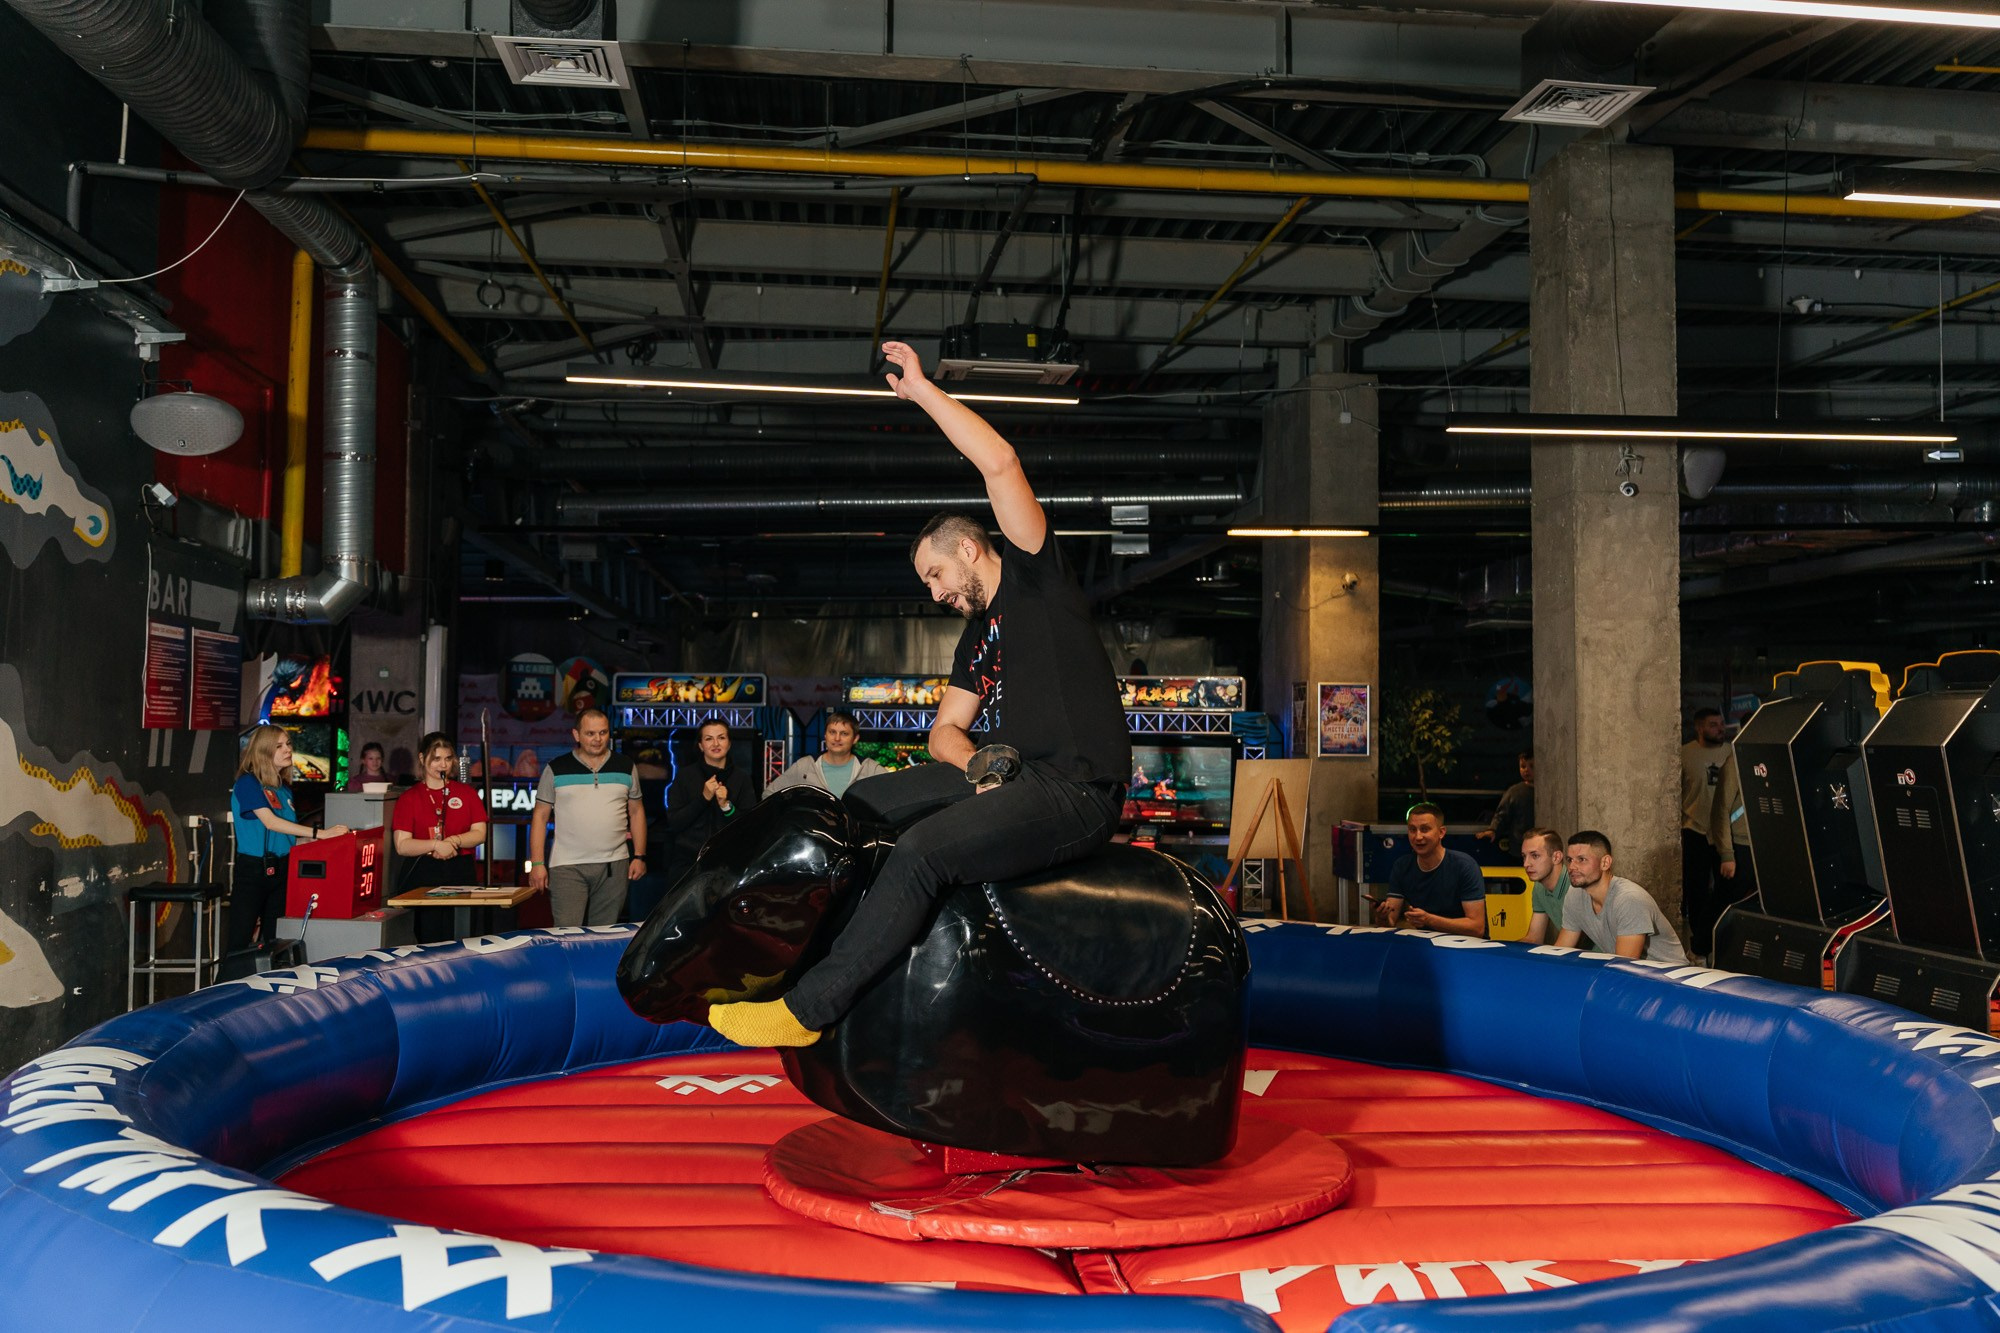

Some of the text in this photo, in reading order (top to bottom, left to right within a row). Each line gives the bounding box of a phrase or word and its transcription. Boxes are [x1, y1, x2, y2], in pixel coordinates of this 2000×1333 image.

[150, 570, 188, 616] BAR
[511, 663, 554, 673] ARCADE
[367, 690, 416, 715] WC
[361, 843, 375, 868] 00
